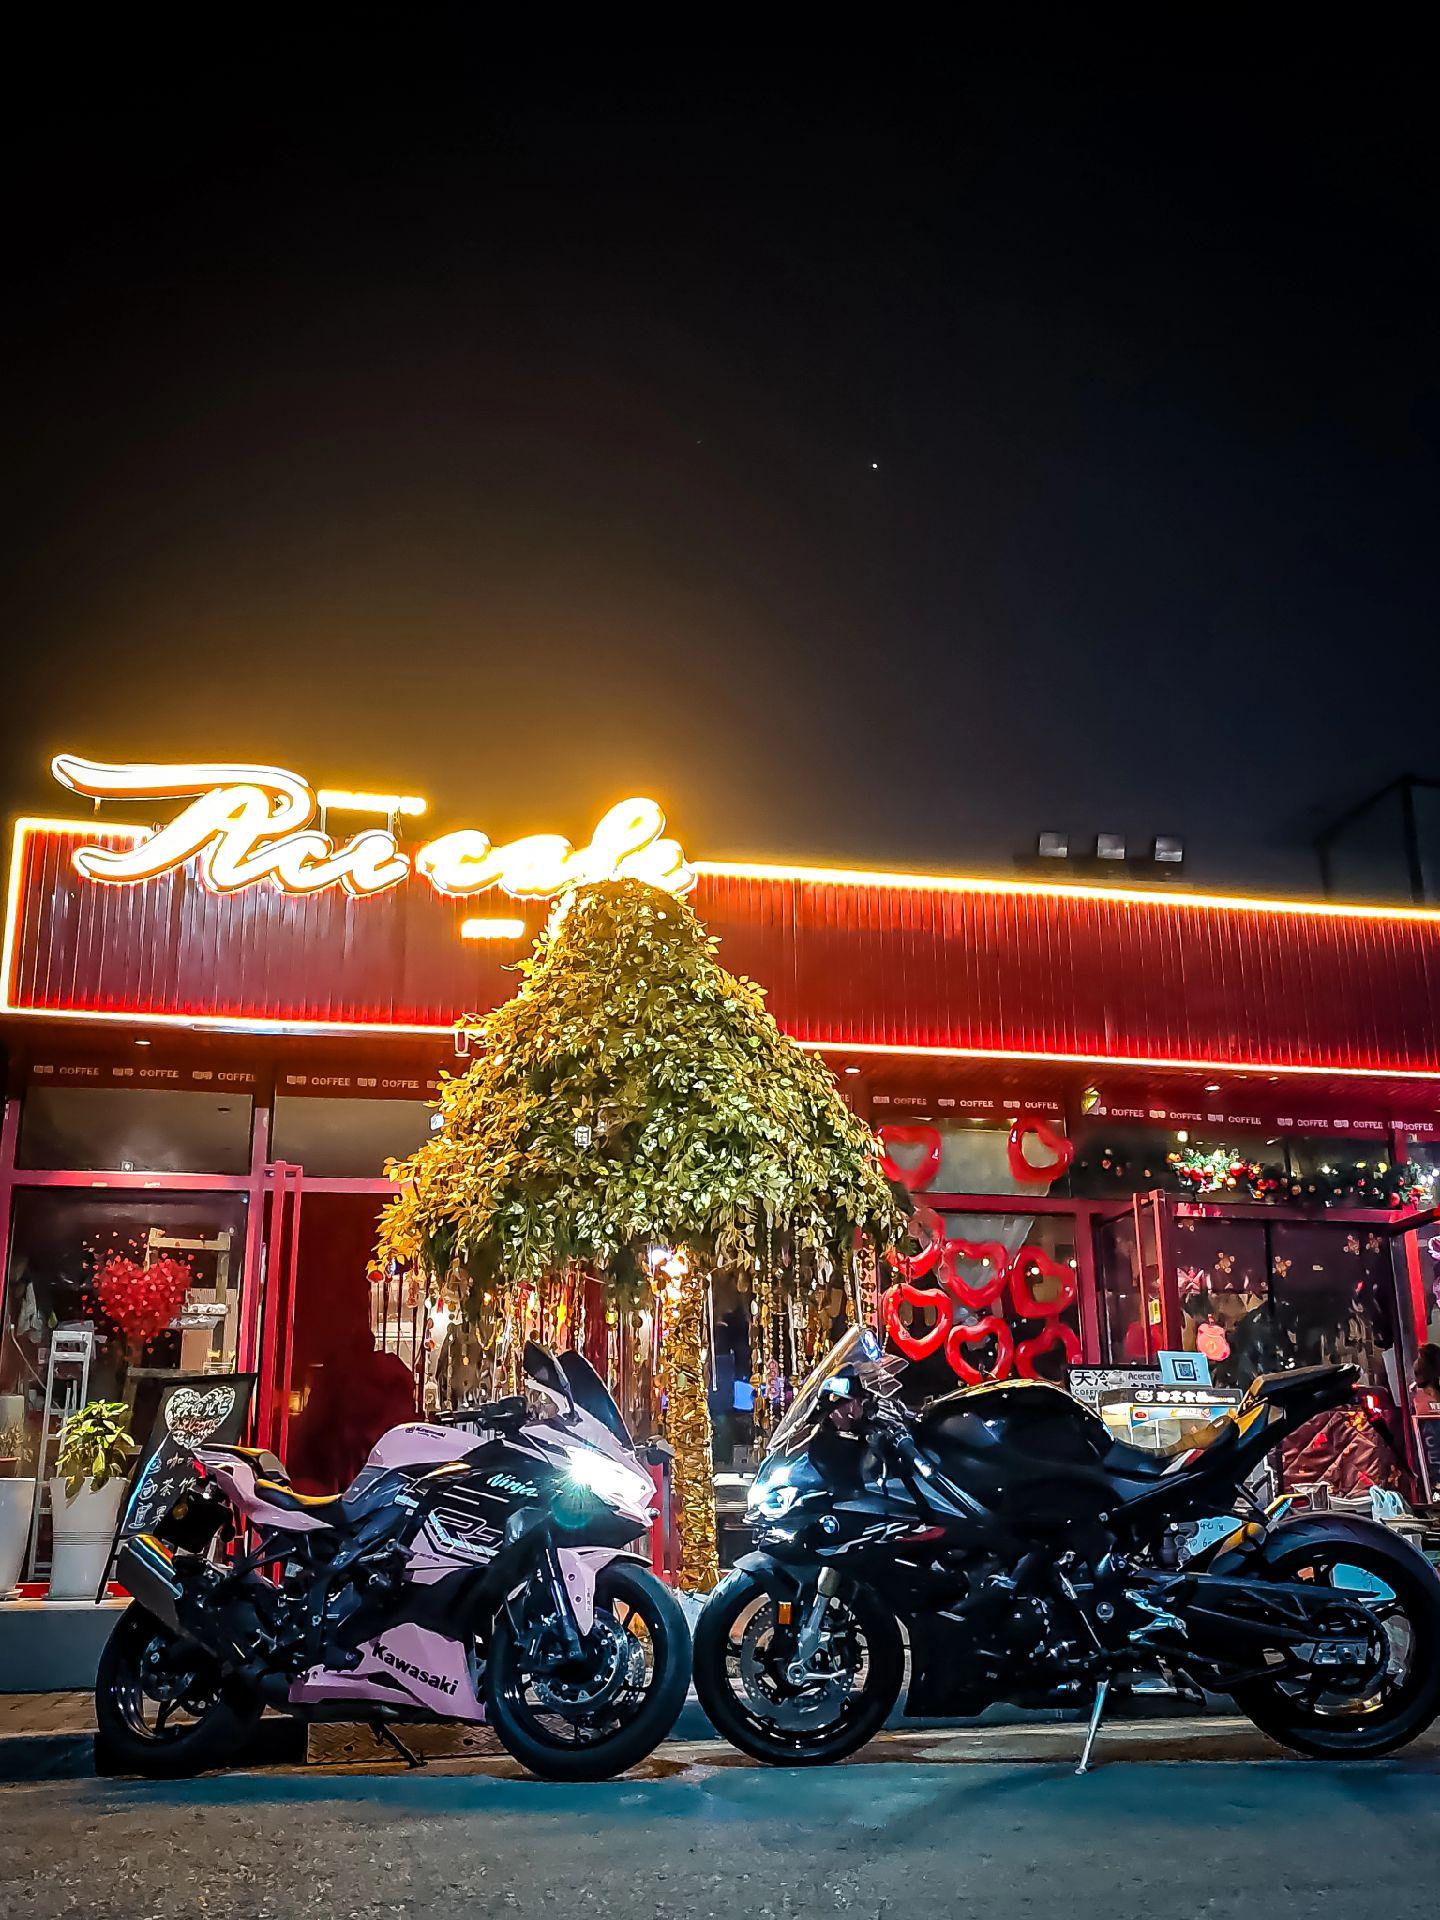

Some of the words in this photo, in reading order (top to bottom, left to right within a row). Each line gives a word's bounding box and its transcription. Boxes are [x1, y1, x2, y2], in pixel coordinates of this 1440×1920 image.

[139, 1069, 180, 1079] COFFEE
[311, 1077, 351, 1087] COFFEE
[381, 1079, 420, 1089] COFFEE
[959, 1099, 995, 1108] COFFEE
[1111, 1108, 1145, 1118] COFFEE
[1169, 1112, 1203, 1121] COFFEE
[1297, 1119, 1329, 1128] COFFEE
[1353, 1120, 1384, 1130] COFFEE
[487, 1473, 539, 1498] Ninja
[371, 1642, 459, 1696] Kawasaki
